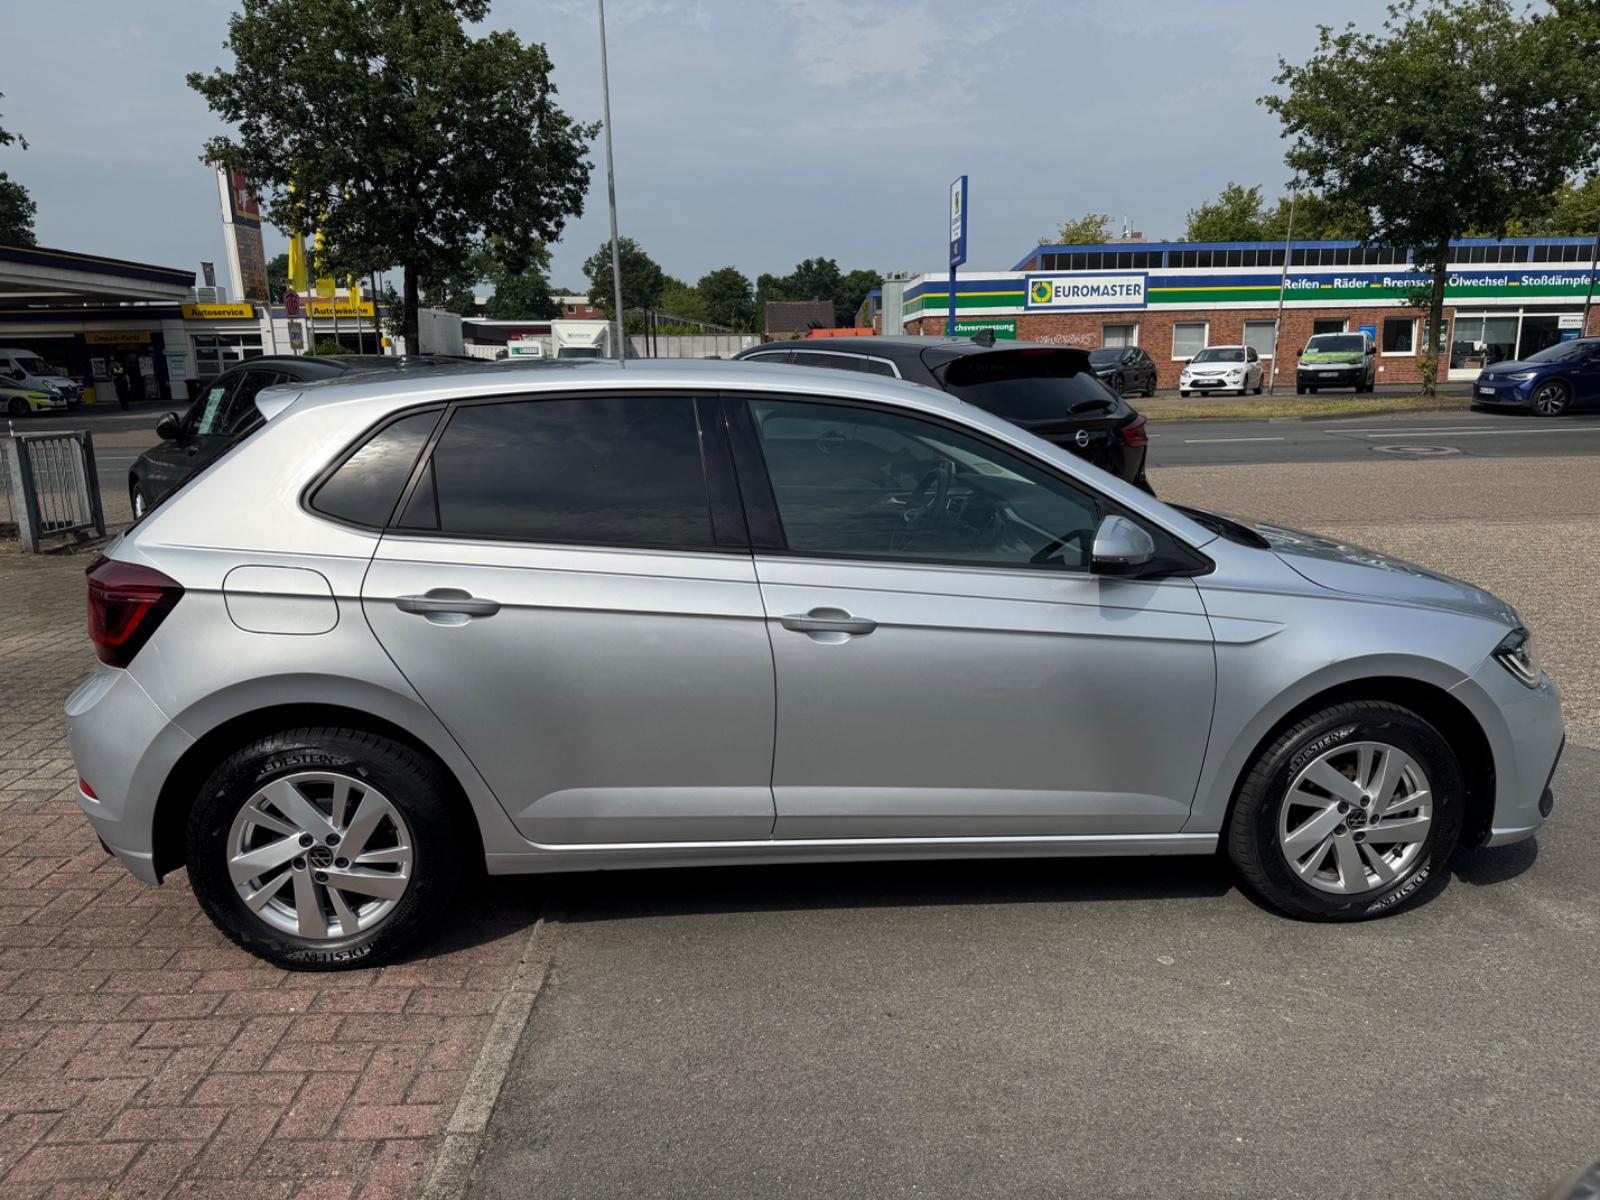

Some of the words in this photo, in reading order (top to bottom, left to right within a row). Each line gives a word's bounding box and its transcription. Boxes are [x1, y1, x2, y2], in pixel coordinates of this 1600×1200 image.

[1284, 279, 1320, 289] Reifen
[1333, 277, 1369, 289] Räder
[1449, 273, 1508, 287] Ölwechsel
[1521, 274, 1598, 288] Stoßdämpfe
[1054, 283, 1142, 298] EUROMASTER
[191, 308, 244, 316] Autoservice
[947, 323, 1015, 332] chsvermessung
